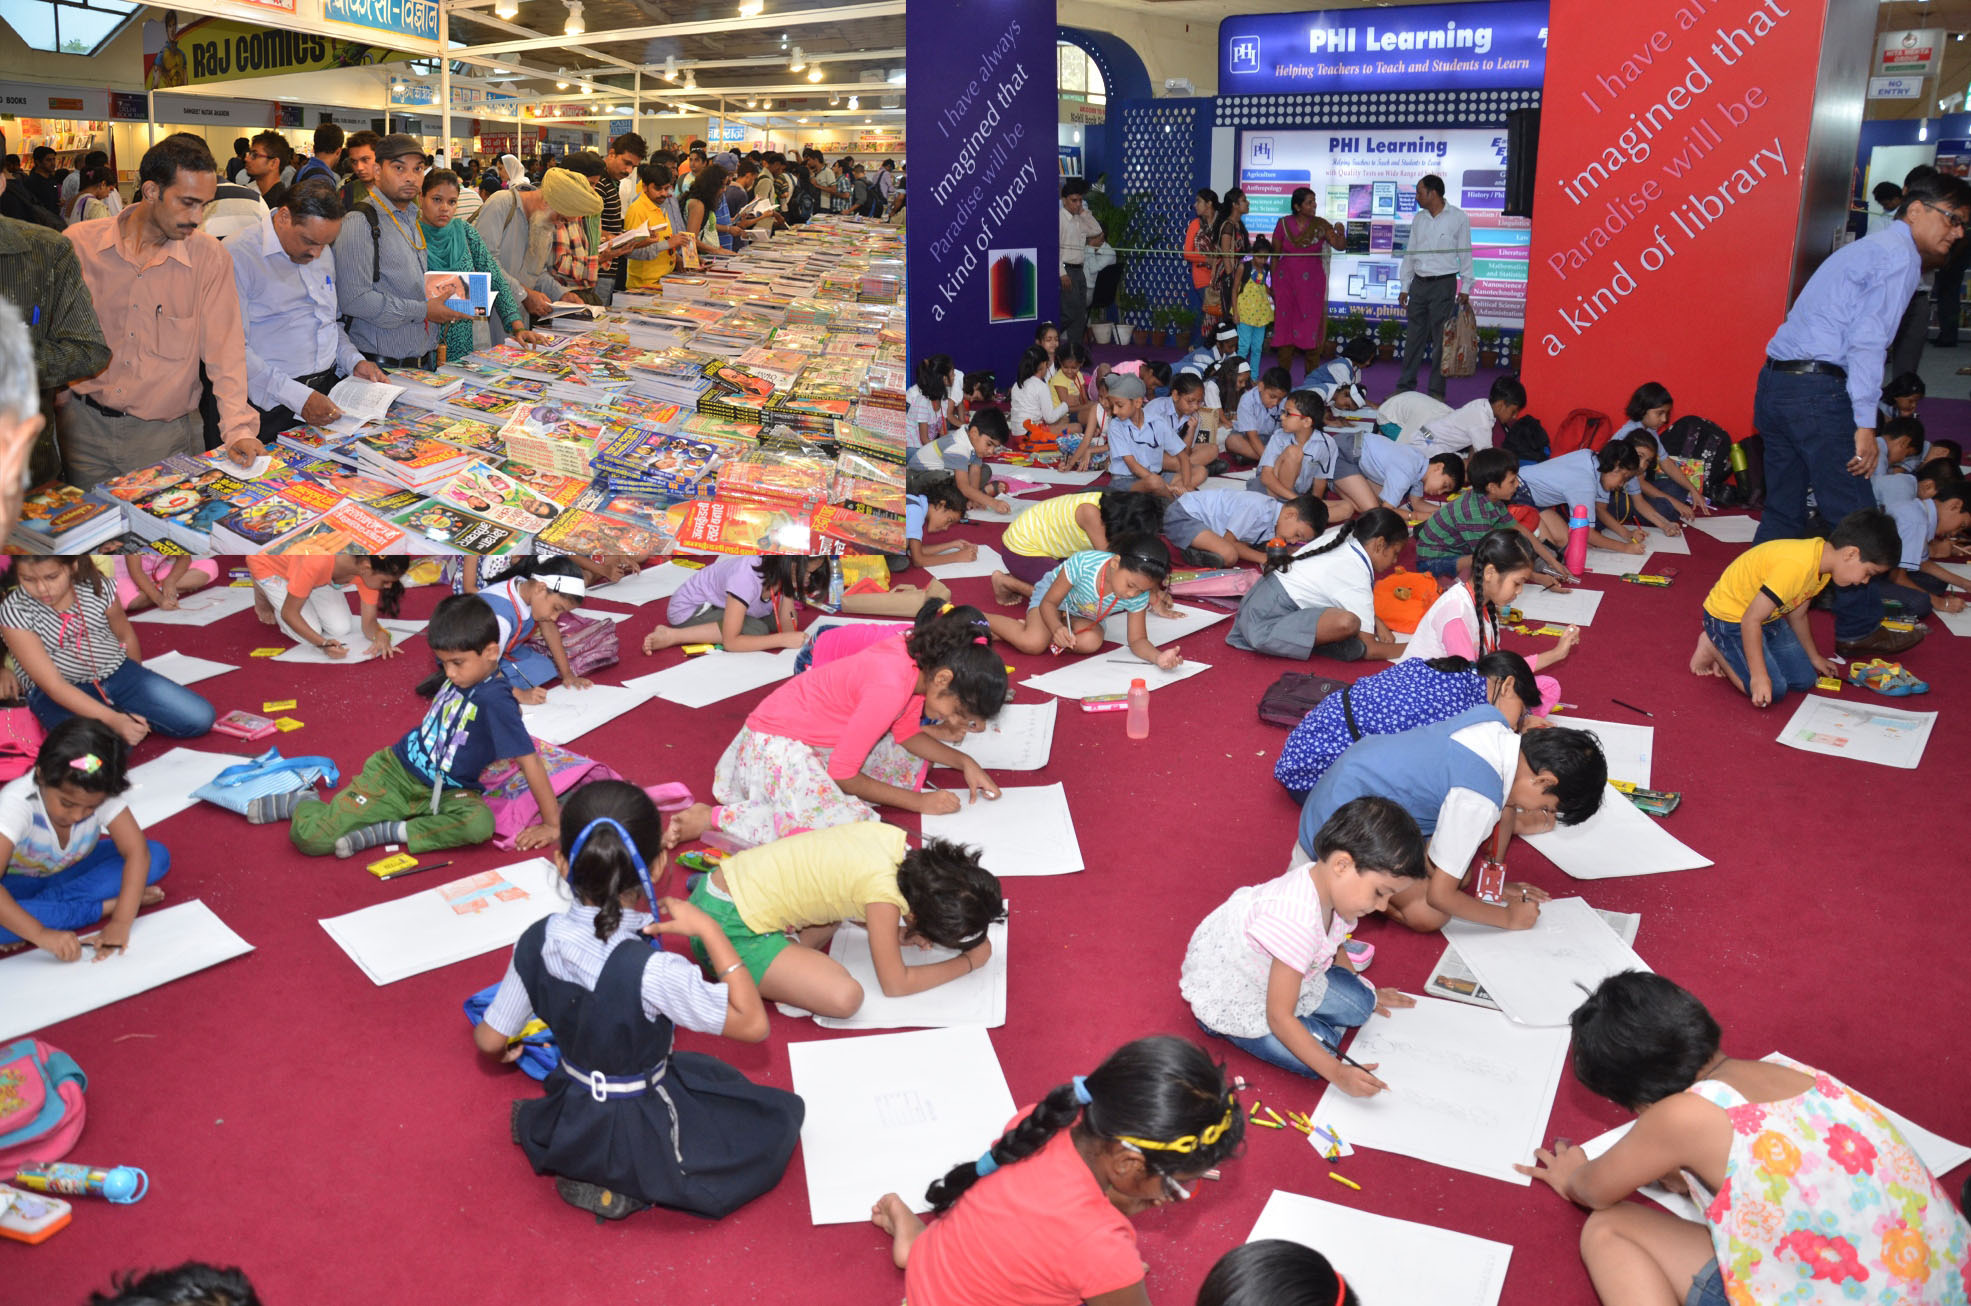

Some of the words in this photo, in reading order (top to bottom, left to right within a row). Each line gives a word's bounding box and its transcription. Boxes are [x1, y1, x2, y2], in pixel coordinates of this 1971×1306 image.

[1309, 27, 1356, 53] PHI
[1366, 21, 1493, 54] Learning
[1233, 43, 1257, 66] PHI
[1275, 64, 1314, 78] Helping
[1317, 62, 1359, 76] Teachers
[1362, 62, 1373, 74] to
[1376, 60, 1405, 74] Teach
[1408, 59, 1429, 73] and
[1432, 58, 1483, 72] Students
[1485, 59, 1494, 69] to
[1497, 57, 1530, 69] Learn
[938, 121, 950, 138] I
[950, 84, 980, 128] have
[981, 18, 1022, 83] always
[1581, 90, 1601, 114] I
[1596, 31, 1672, 98] have
[6, 97, 27, 105] BOOKS
[1558, 57, 1713, 205] imagined
[1712, 0, 1790, 66] that
[930, 100, 1001, 206] imagined
[997, 63, 1030, 110] that
[1329, 137, 1360, 153] PHI
[1367, 136, 1448, 157] Learning
[1253, 142, 1271, 160] PHI
[1247, 171, 1276, 179] Agriculture
[1339, 168, 1361, 177] Quality
[1400, 170, 1417, 178] Range
[1547, 179, 1664, 281] Paradise
[1663, 118, 1723, 179] will
[1716, 84, 1769, 127] be
[930, 185, 984, 263] Paradise
[982, 143, 1010, 185] will
[1006, 121, 1025, 149] be
[989, 156, 1039, 227] library
[1467, 191, 1489, 199] History
[976, 218, 997, 251] of
[1542, 333, 1566, 357] a
[1558, 260, 1638, 335] kind
[1640, 224, 1675, 271] of
[1670, 136, 1790, 239] library
[938, 245, 978, 304] kind
[1482, 281, 1521, 289] Nanoscience
[1473, 288, 1525, 297] Nanotechnology
[932, 305, 945, 322] a
